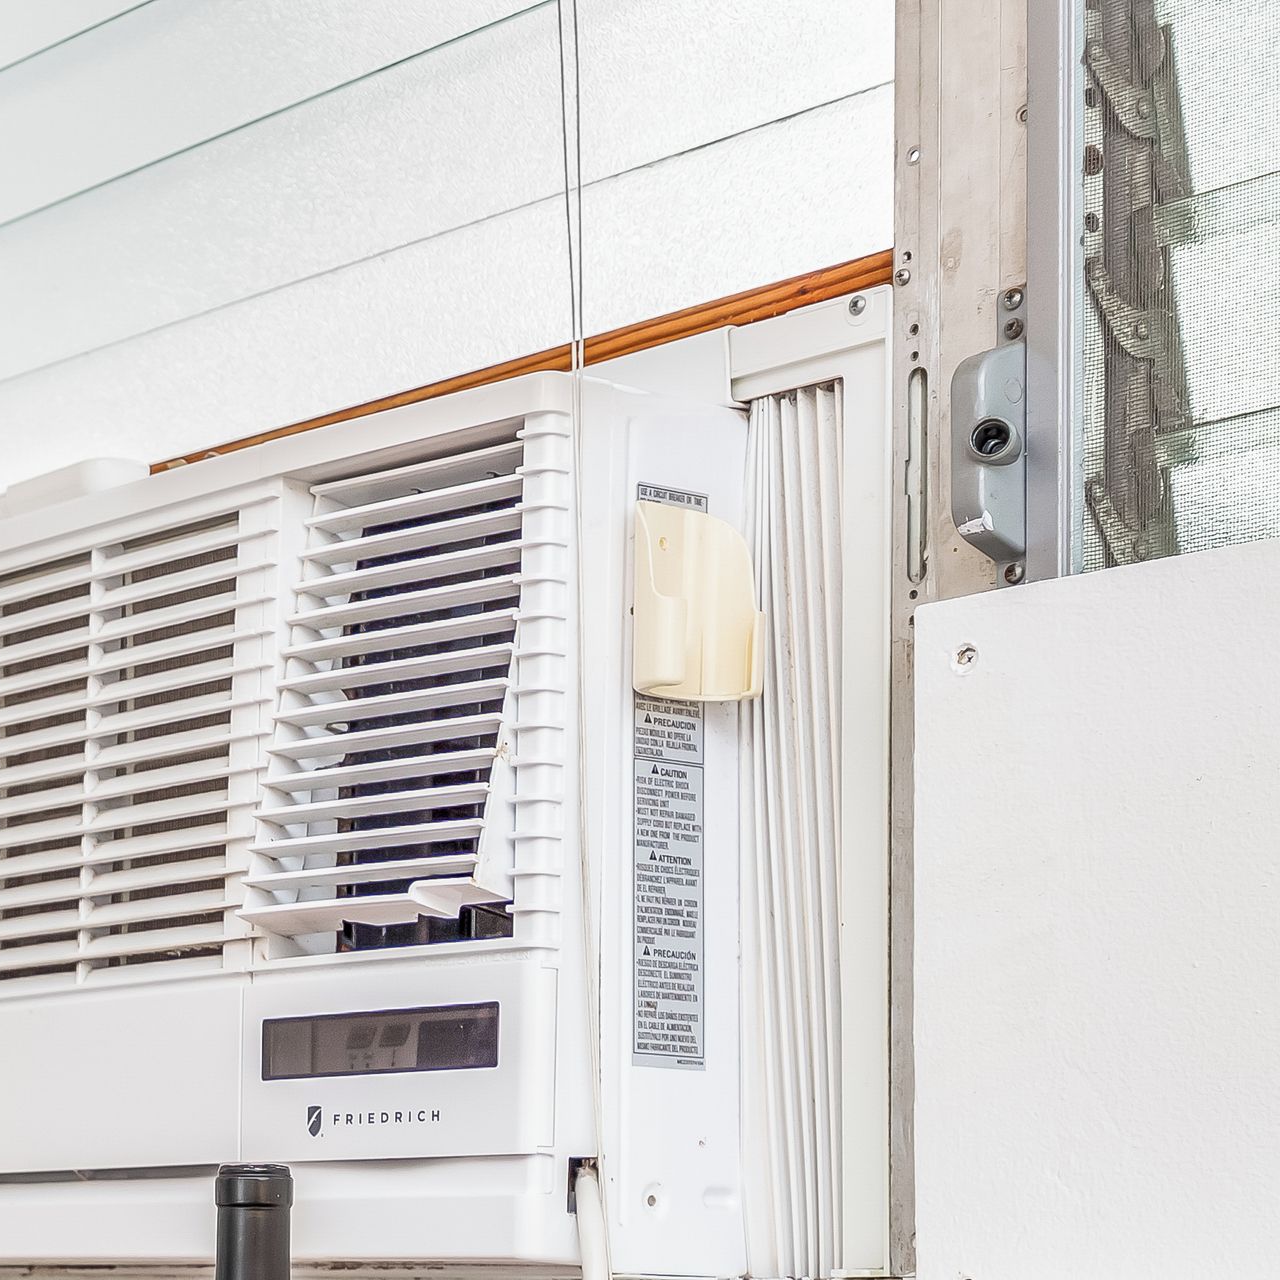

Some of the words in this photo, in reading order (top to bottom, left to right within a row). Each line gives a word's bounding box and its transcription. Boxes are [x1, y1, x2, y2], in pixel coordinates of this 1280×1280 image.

[654, 717, 696, 730] PRECAUCION
[661, 768, 687, 779] CAUTION
[648, 777, 653, 785] OF
[655, 778, 674, 788] ELECTRIC
[659, 855, 691, 865] ATTENTION
[654, 949, 696, 960] PRECAUCIÓN
[334, 1110, 440, 1125] FRIEDRICH
